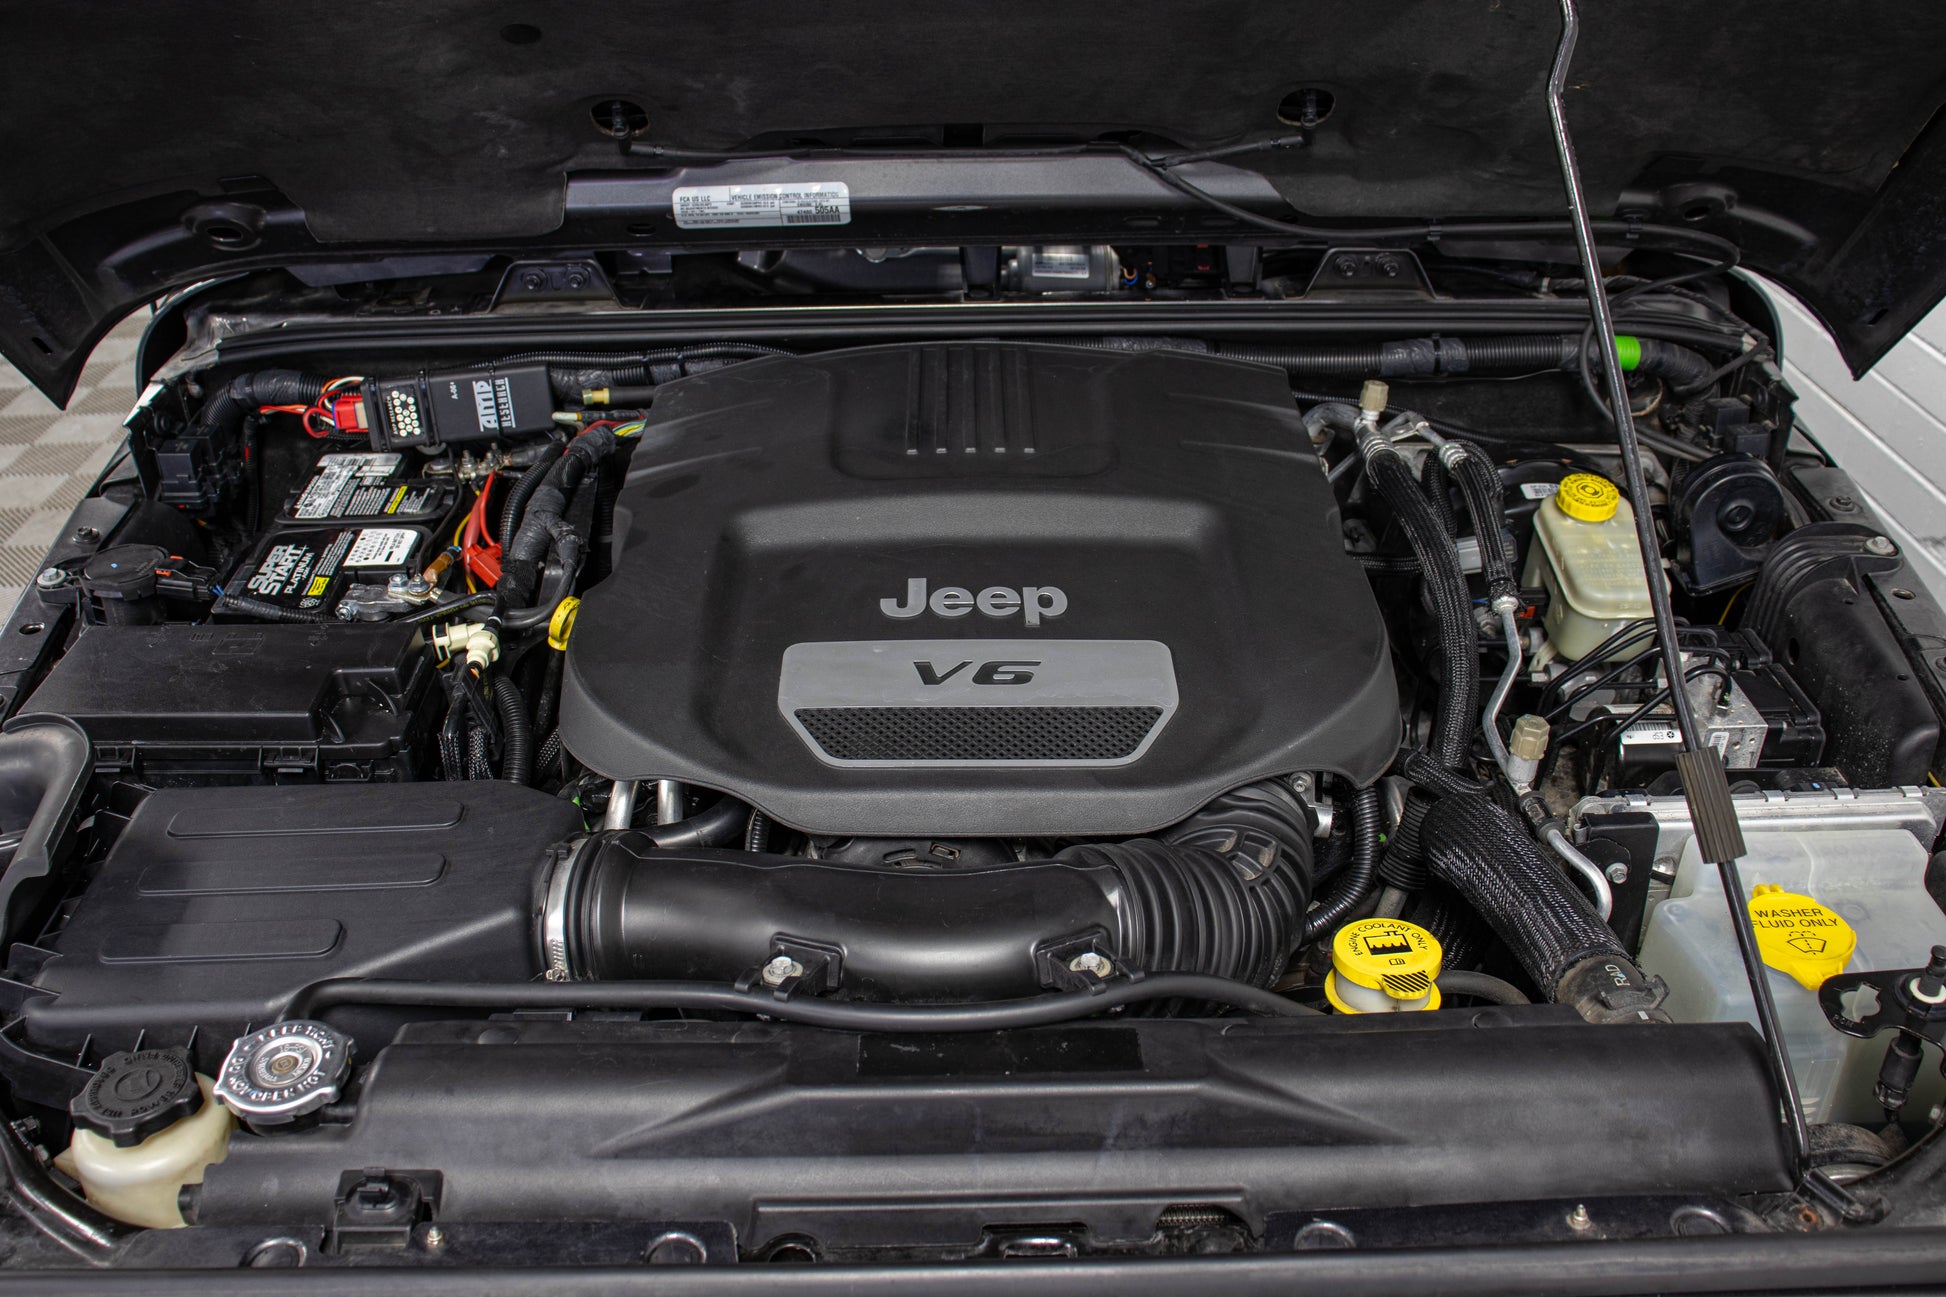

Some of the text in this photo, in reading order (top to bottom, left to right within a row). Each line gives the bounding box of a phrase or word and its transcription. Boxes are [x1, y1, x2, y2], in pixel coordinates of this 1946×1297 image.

[731, 193, 752, 201] VEHICLE
[815, 205, 840, 215] 505AA
[475, 380, 499, 430] AMP
[495, 378, 512, 428] RESEARCH
[247, 544, 288, 590] SUPER
[259, 543, 297, 595] START
[283, 552, 316, 594] PLATINUM
[880, 578, 1068, 627] Jeep
[914, 661, 1042, 685] V6
[1754, 908, 1823, 918] WASHER
[1800, 918, 1838, 928] ONLY
[1348, 922, 1429, 956] ENGINE COOLANT ONLY
